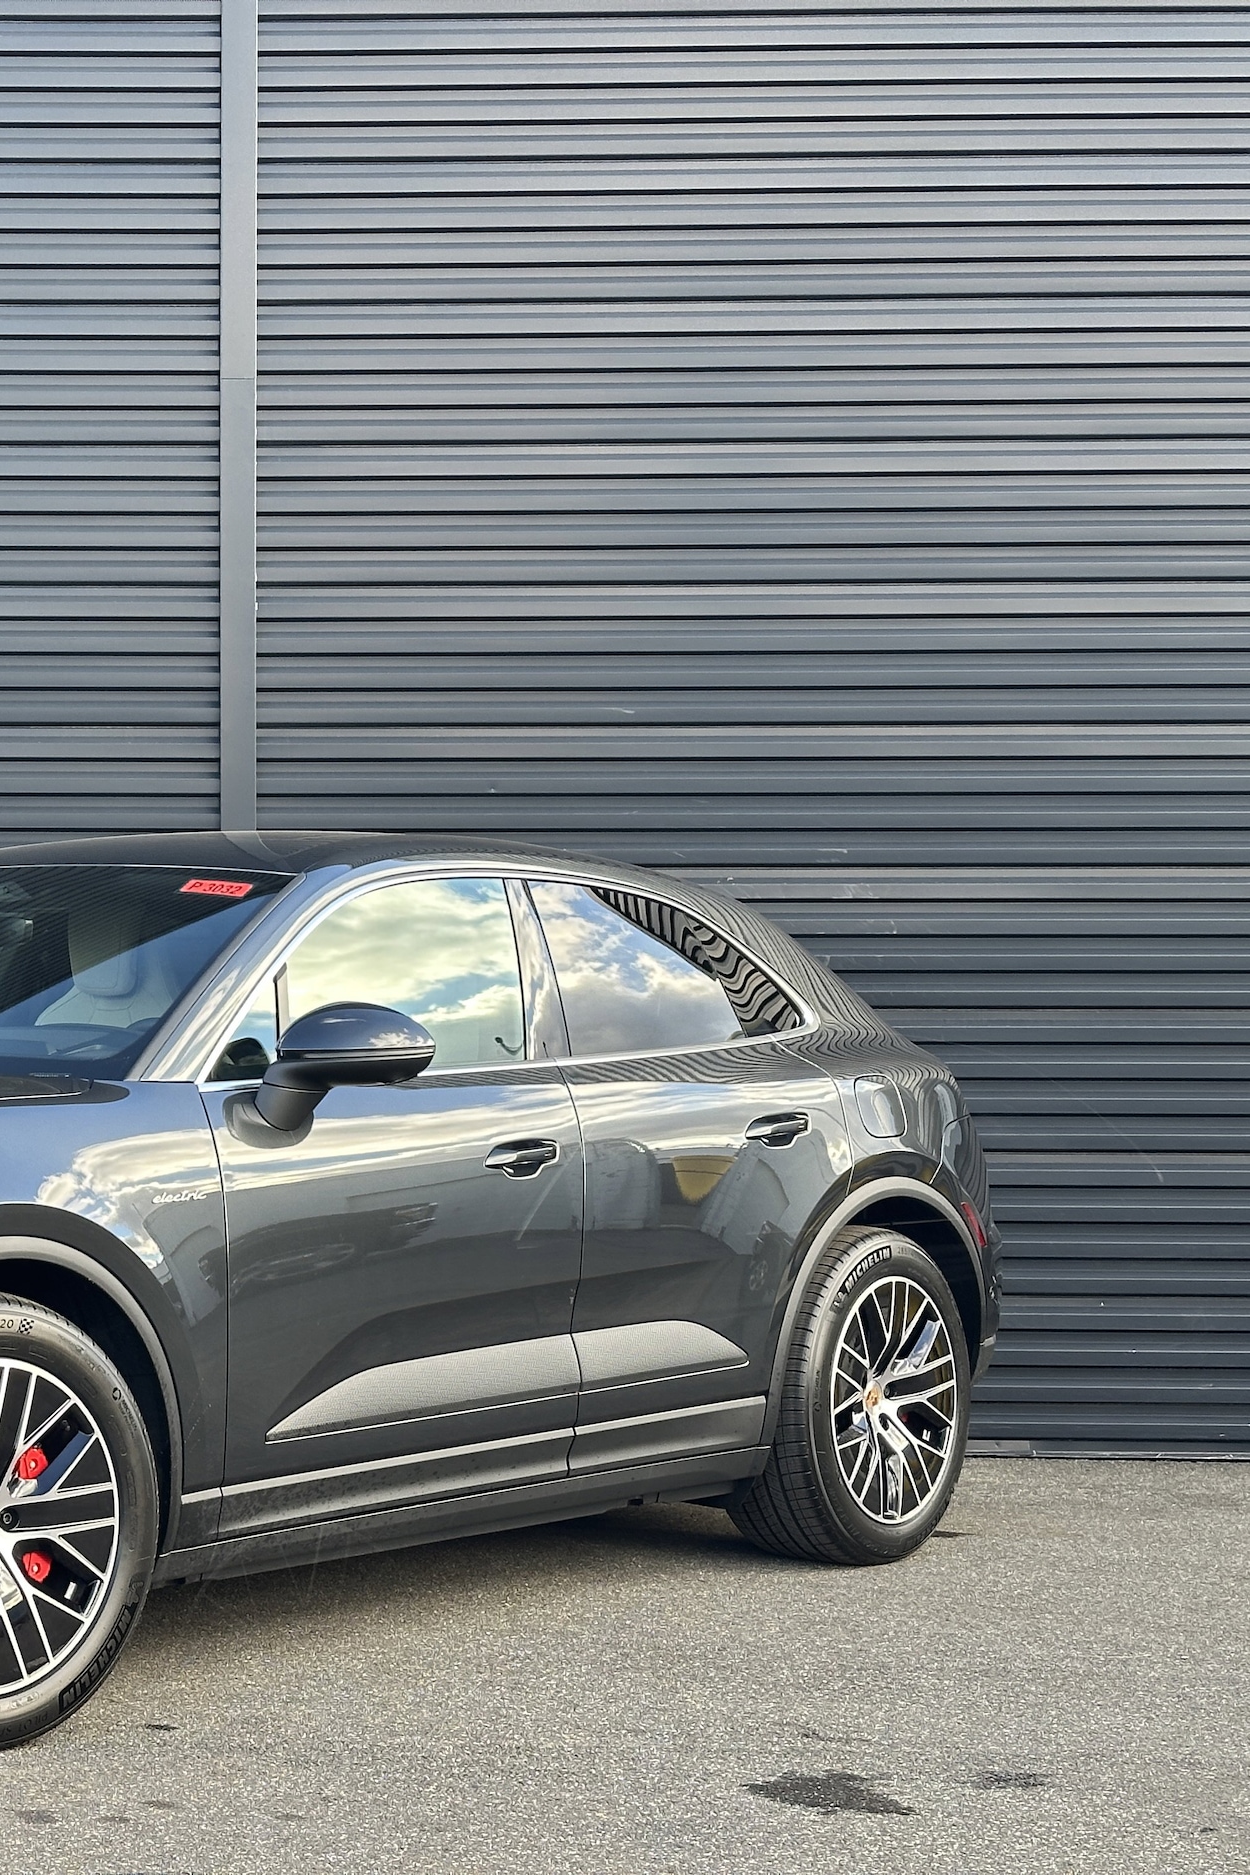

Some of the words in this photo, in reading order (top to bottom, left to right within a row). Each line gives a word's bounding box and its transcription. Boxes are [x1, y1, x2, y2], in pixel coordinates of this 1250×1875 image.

[188, 881, 203, 890] P
[203, 883, 242, 894] 3032
[152, 1190, 207, 1204] electric
[844, 1247, 890, 1293] MICHELIN
[0, 1319, 15, 1329] 20
[63, 1608, 132, 1710] MICHELIN
